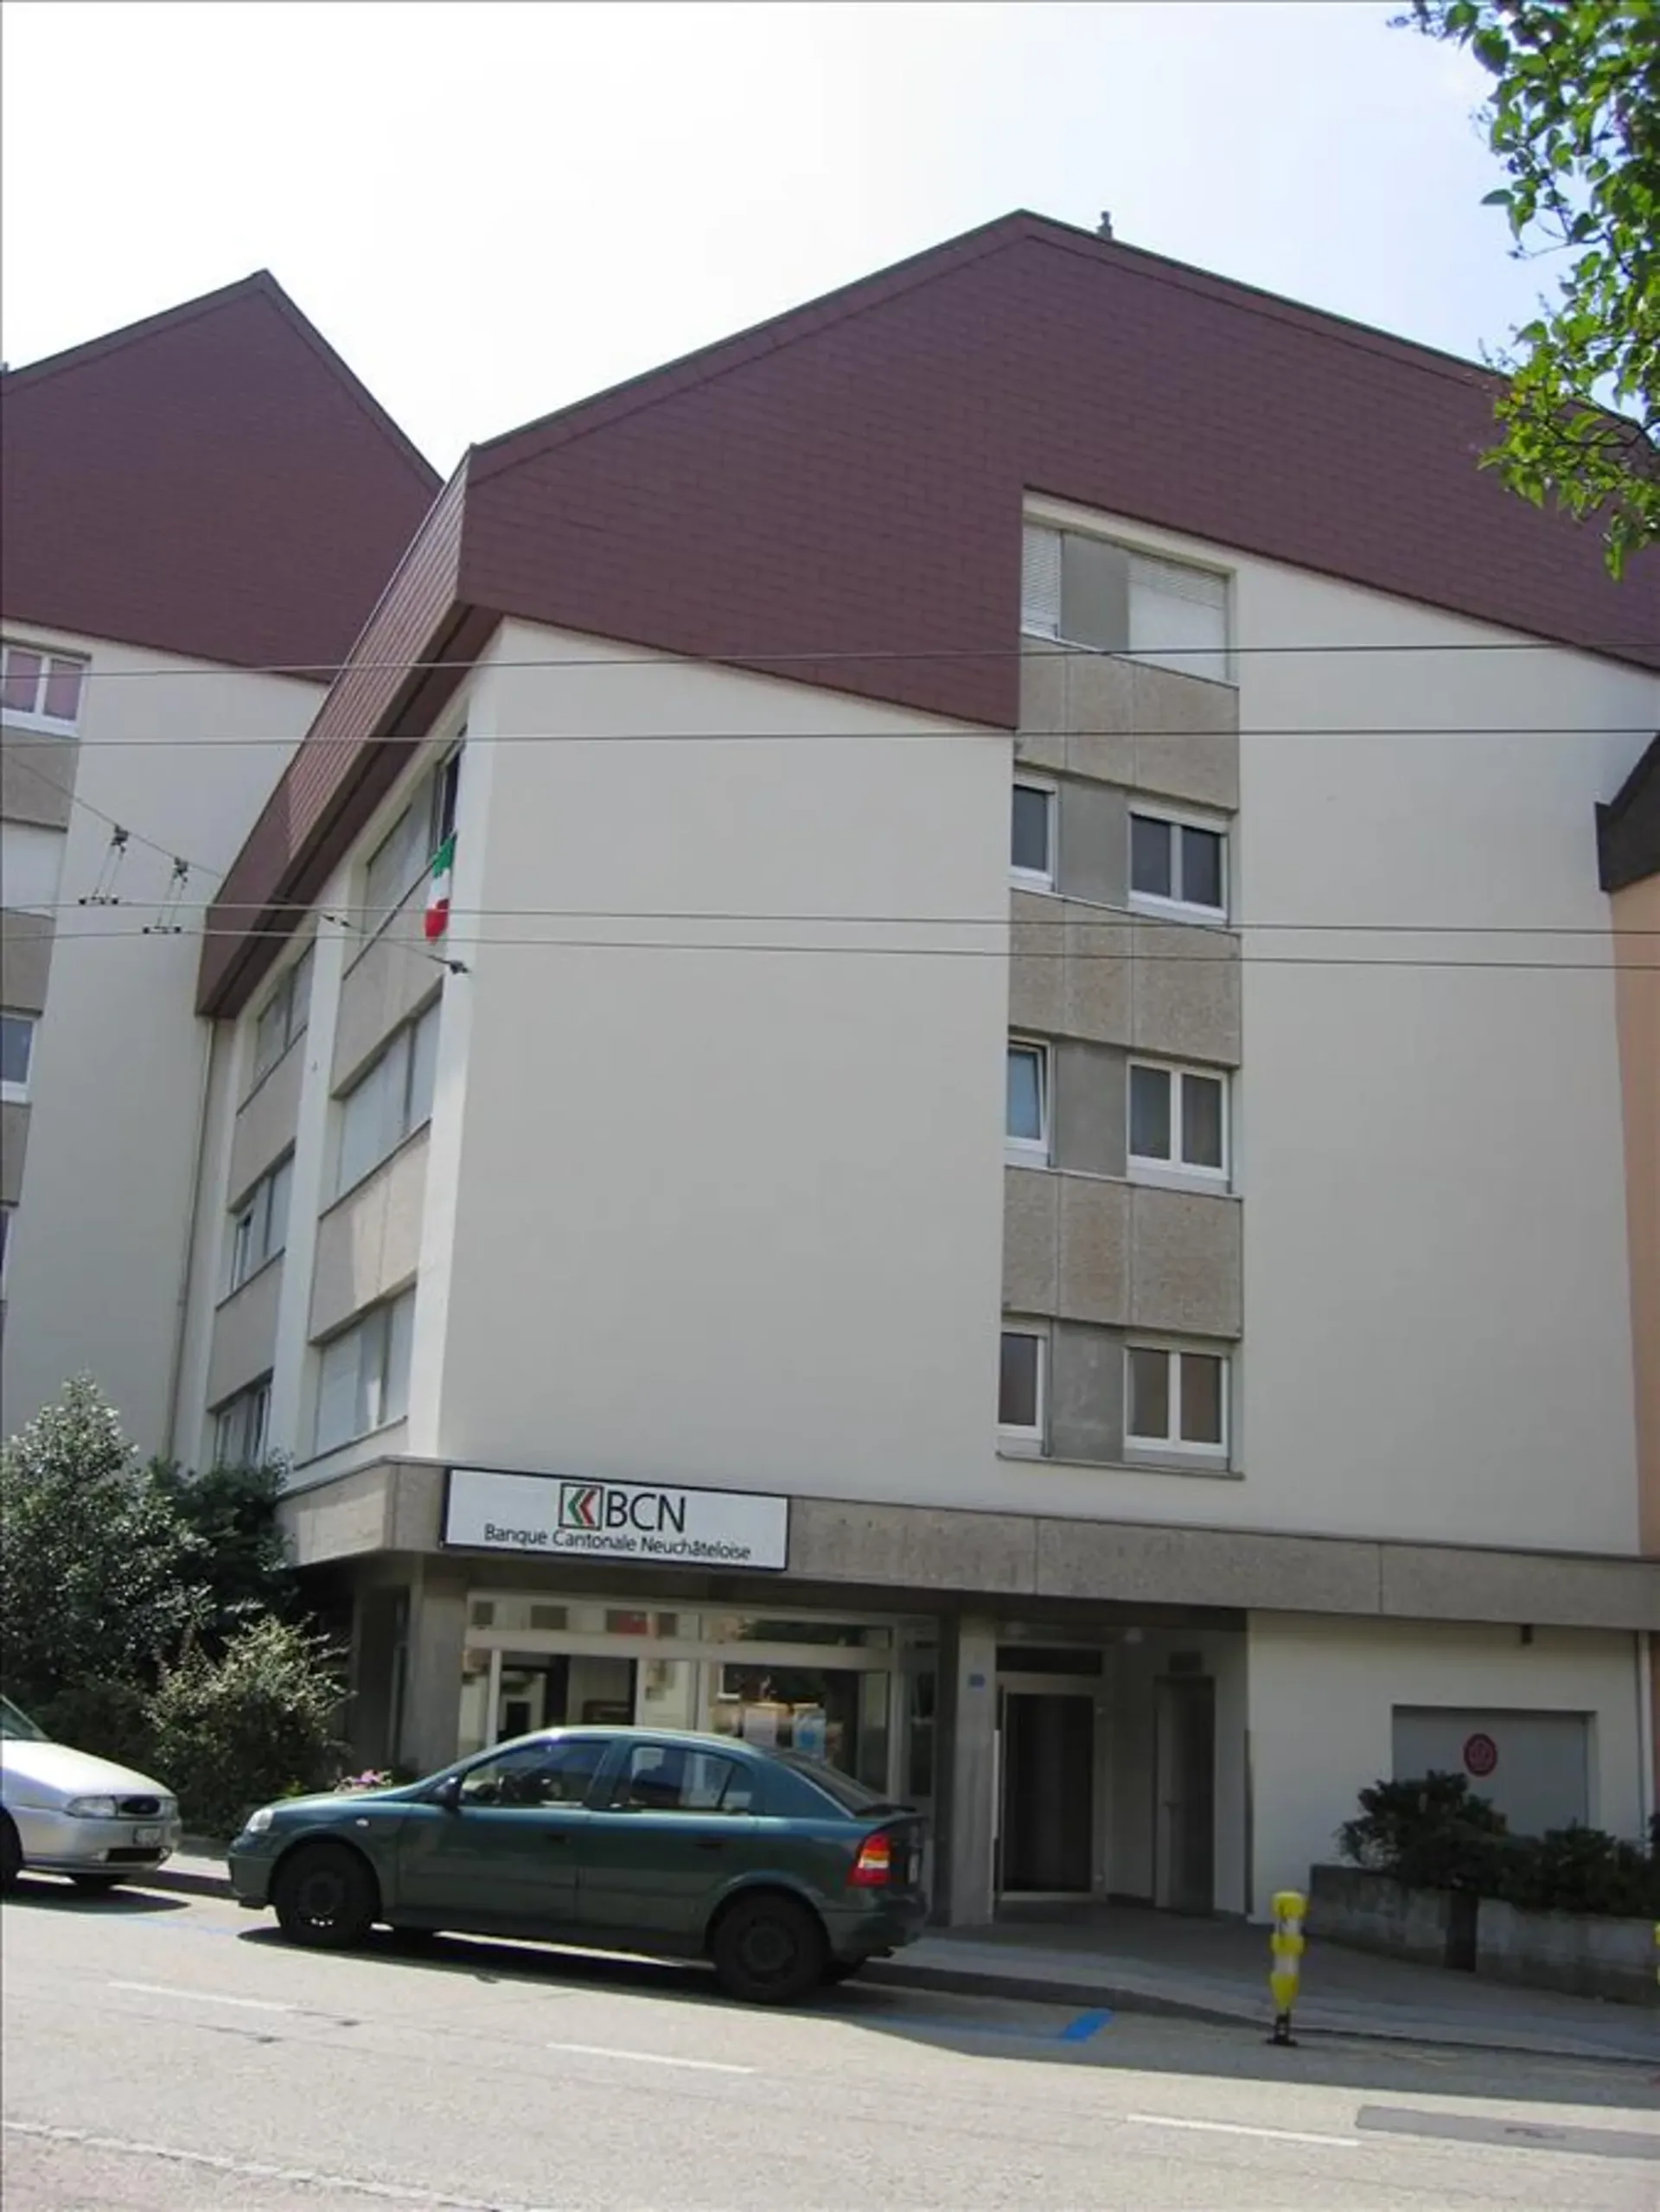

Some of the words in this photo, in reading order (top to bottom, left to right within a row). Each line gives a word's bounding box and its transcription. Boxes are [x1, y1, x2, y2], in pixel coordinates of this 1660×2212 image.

[605, 1490, 686, 1533] BCN
[484, 1523, 548, 1546] Banque
[552, 1530, 635, 1552] Cantonale
[641, 1537, 750, 1559] Neuchâteloise
